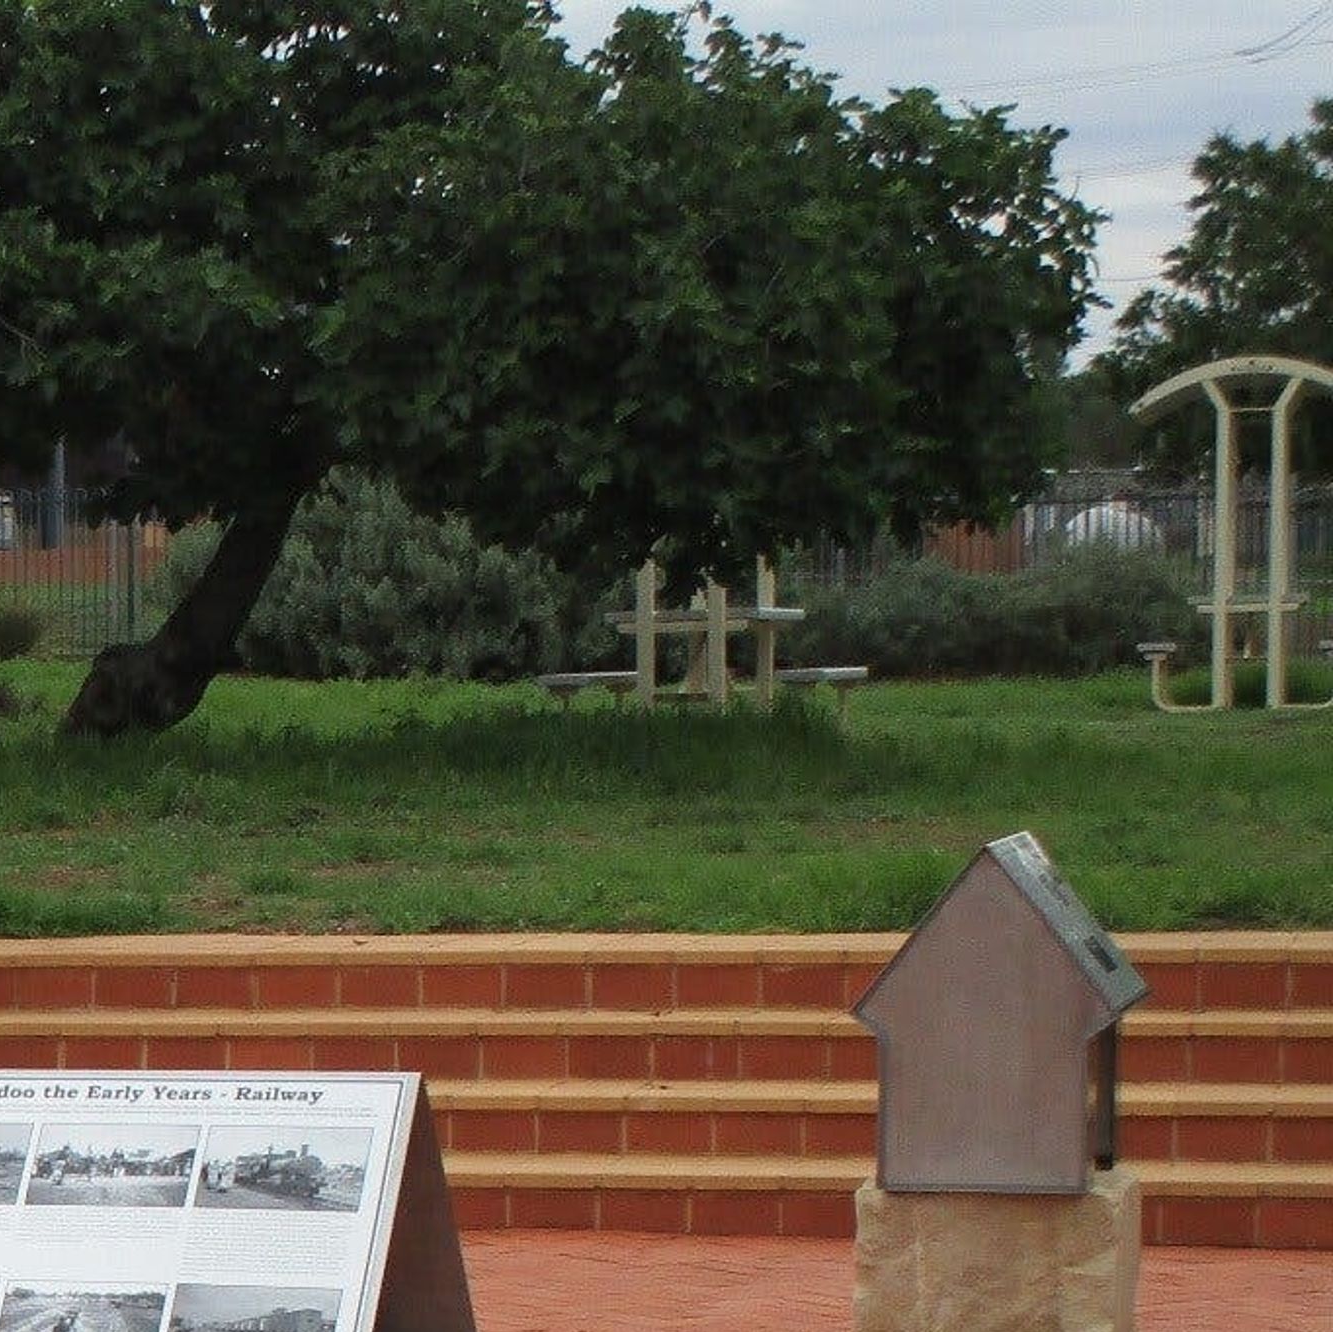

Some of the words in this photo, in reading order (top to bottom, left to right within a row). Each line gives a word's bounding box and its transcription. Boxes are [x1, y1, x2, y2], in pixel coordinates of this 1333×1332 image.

[43, 1084, 78, 1099] the
[87, 1085, 142, 1102] Early
[153, 1086, 212, 1101] Years
[235, 1087, 324, 1103] Railway
